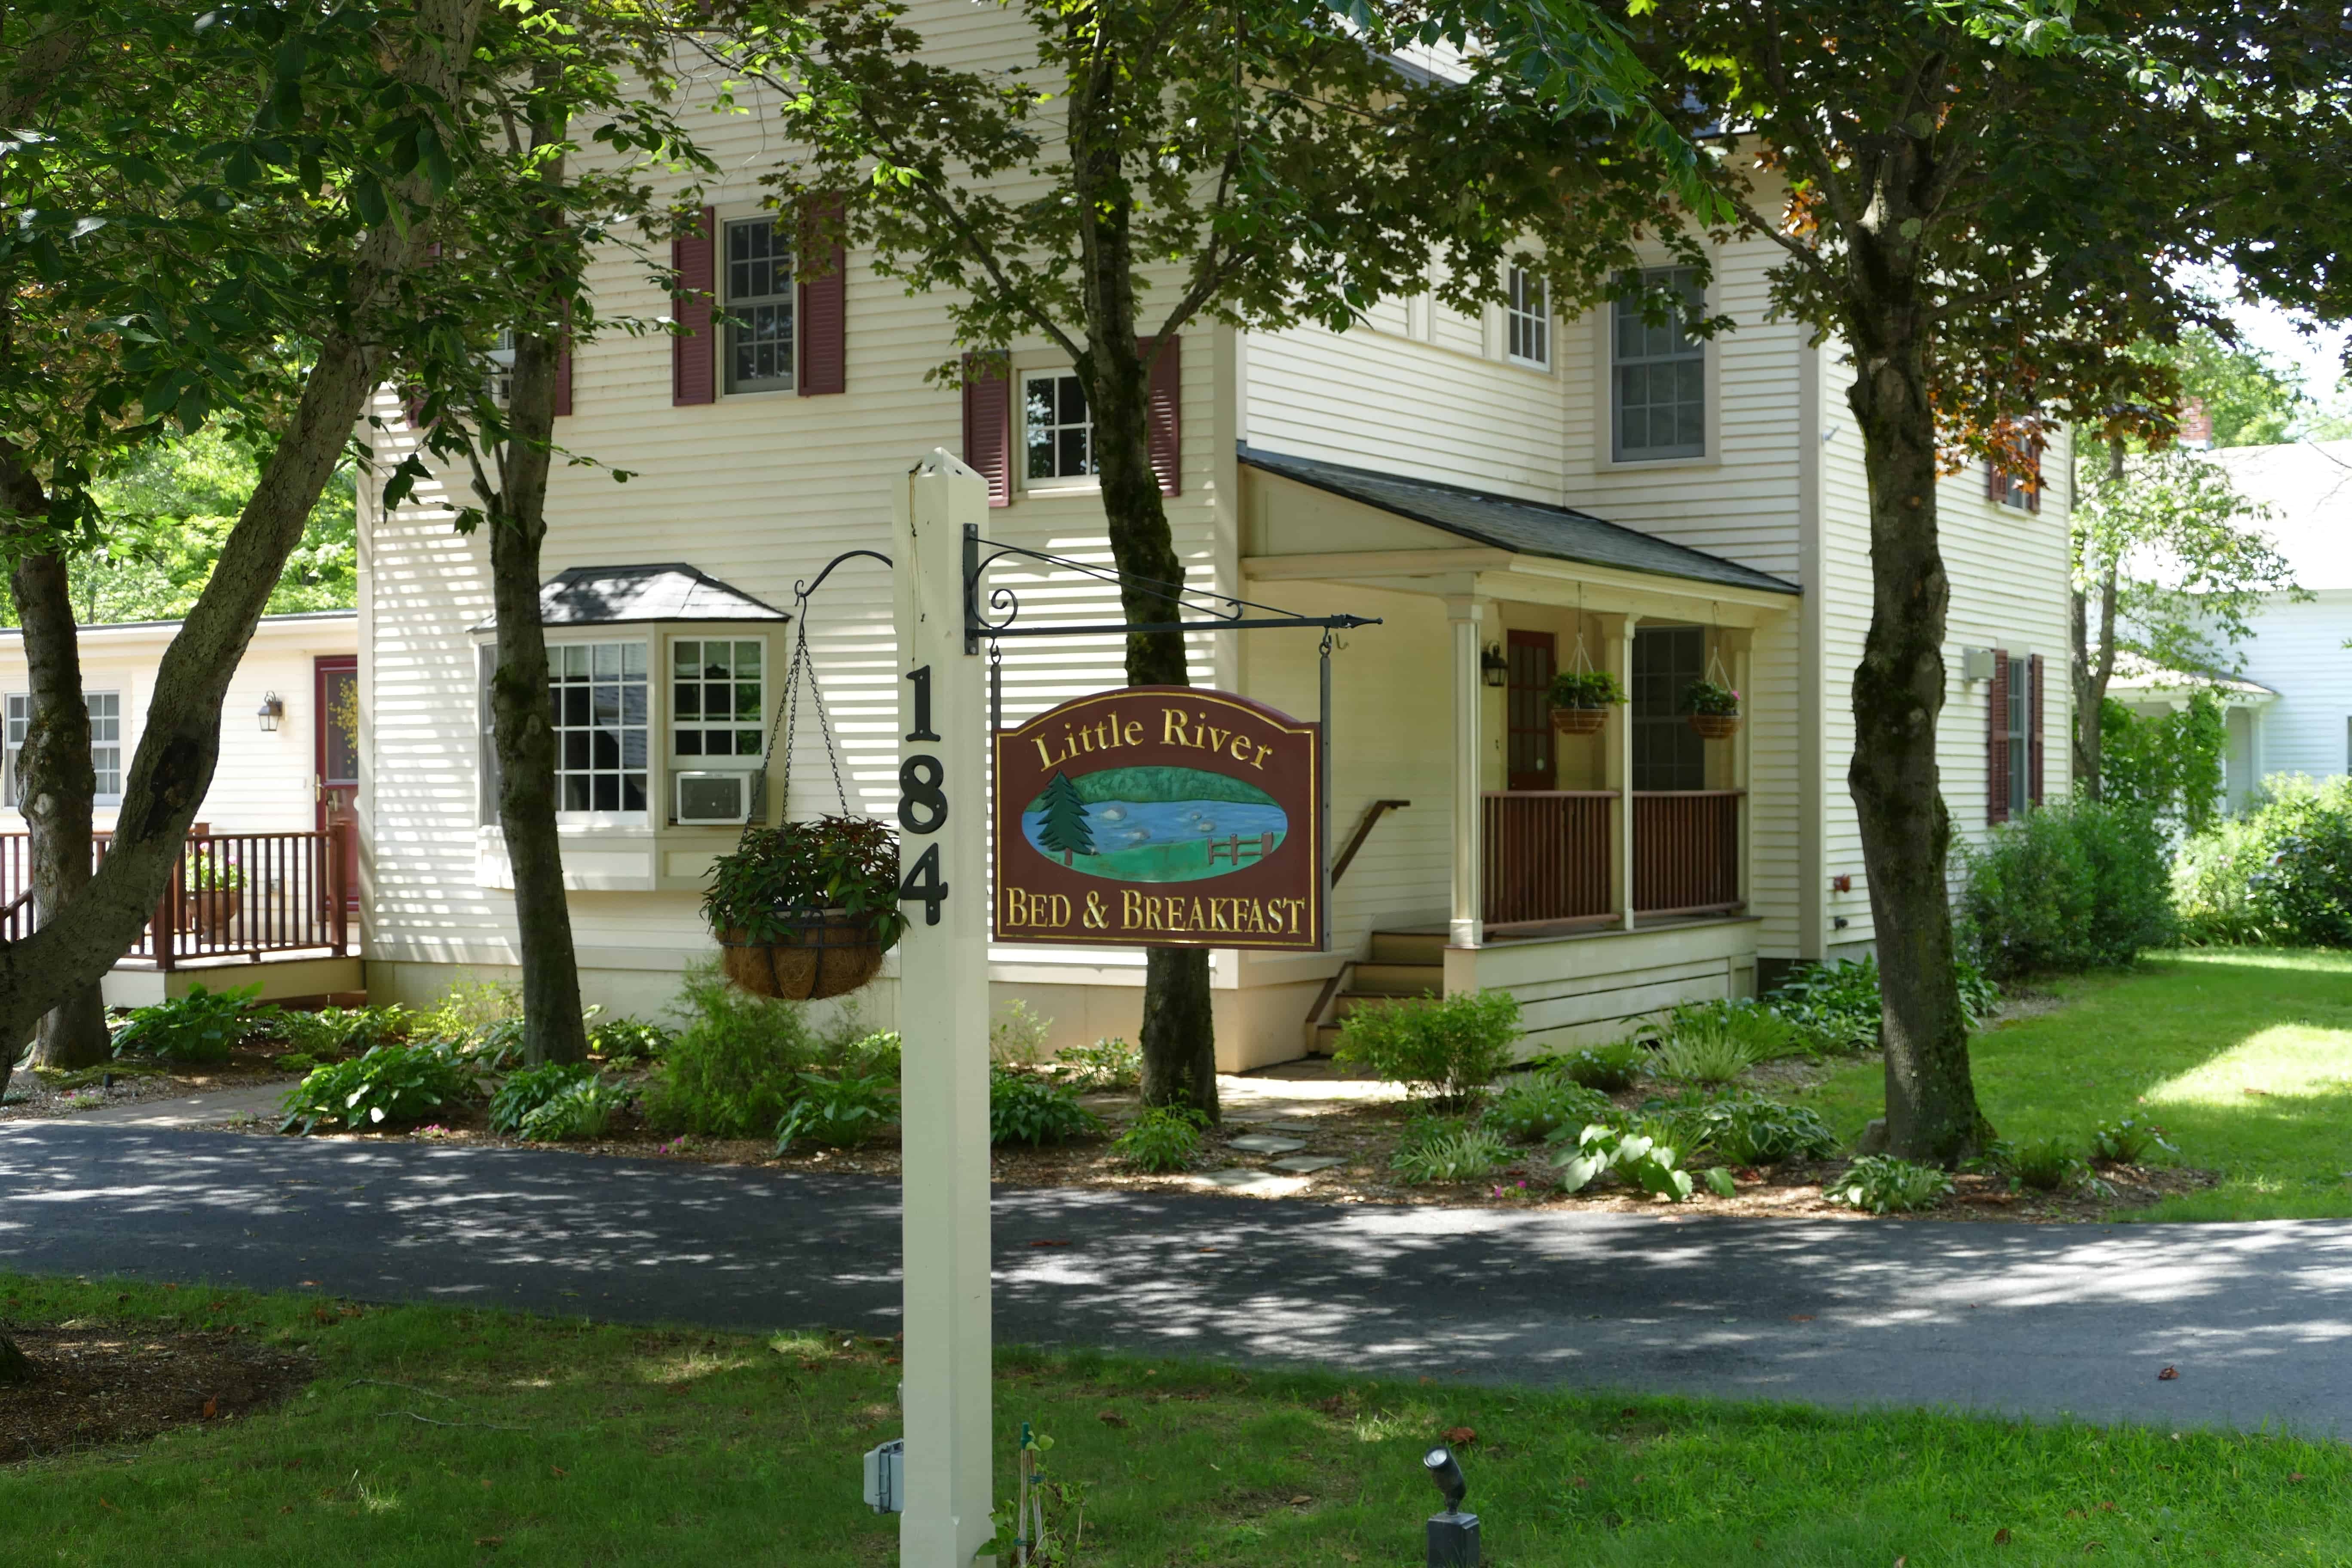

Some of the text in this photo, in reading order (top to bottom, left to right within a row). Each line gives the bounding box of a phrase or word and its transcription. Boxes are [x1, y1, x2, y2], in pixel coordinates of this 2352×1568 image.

[1031, 708, 1274, 772] Little River
[898, 665, 948, 925] 184
[1006, 887, 1305, 934] BED & BREAKFAST
